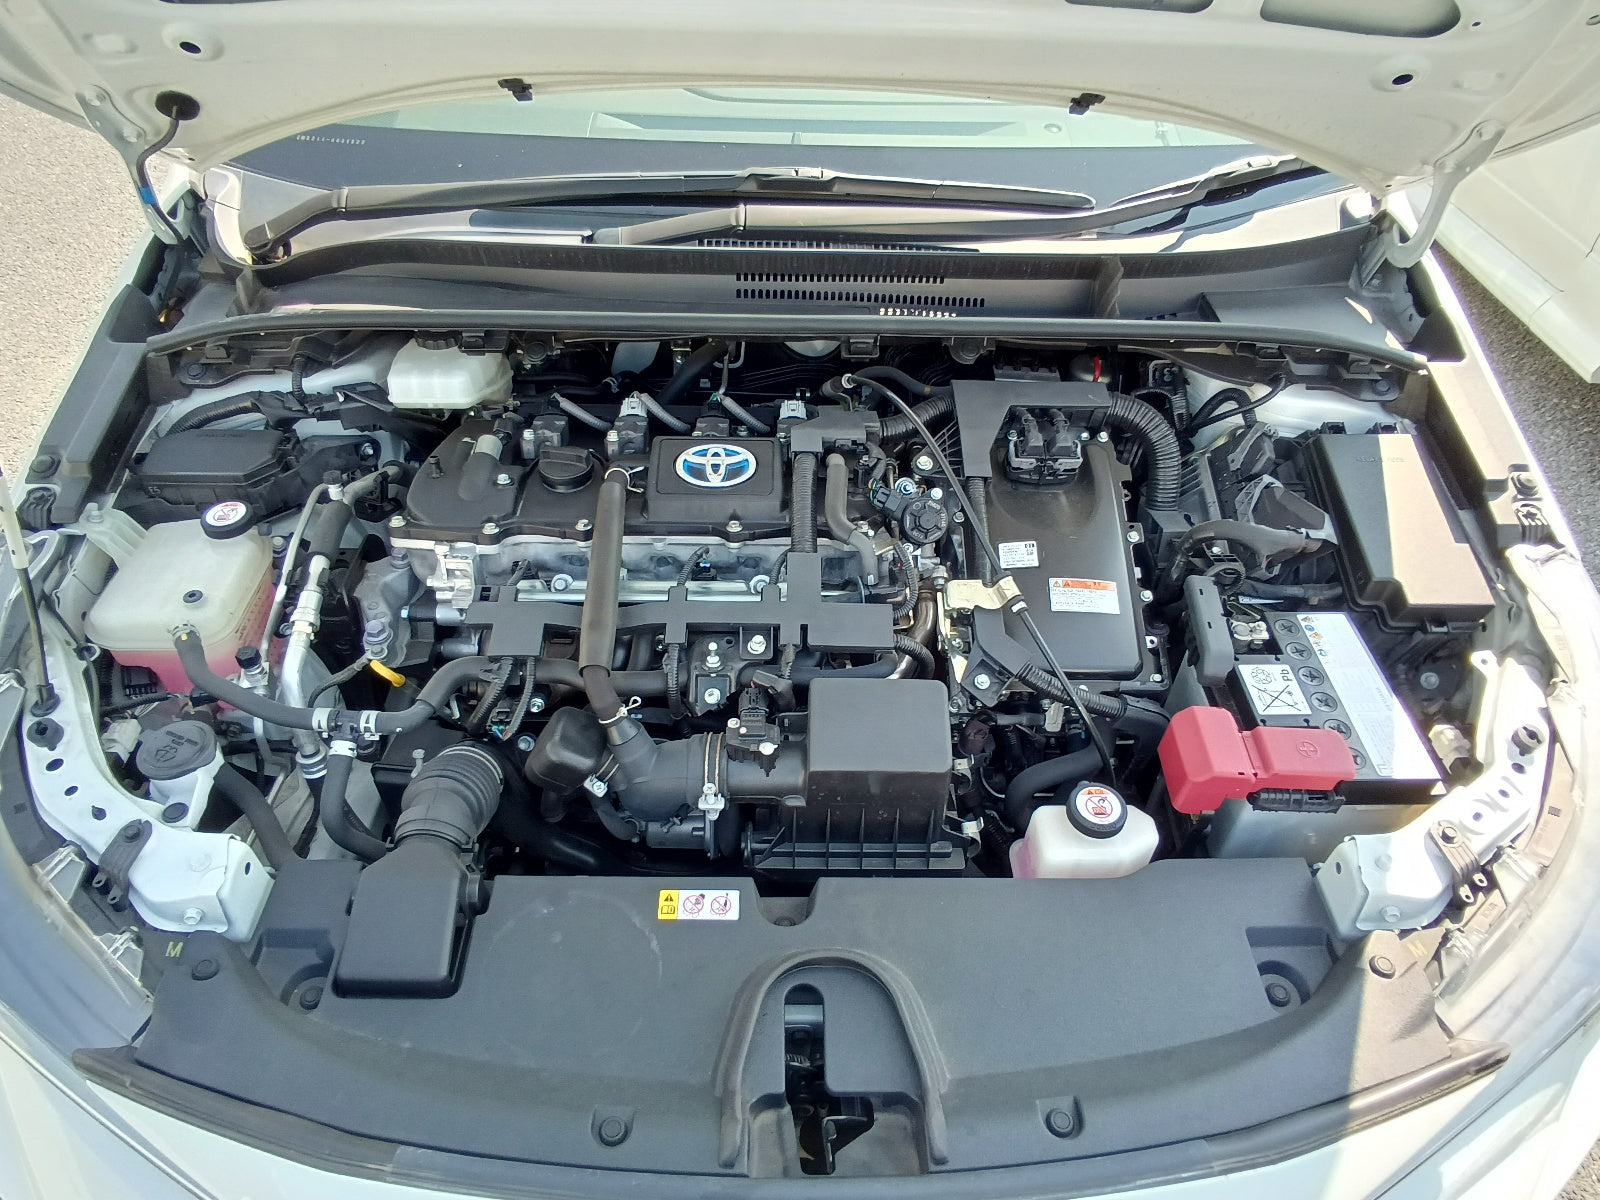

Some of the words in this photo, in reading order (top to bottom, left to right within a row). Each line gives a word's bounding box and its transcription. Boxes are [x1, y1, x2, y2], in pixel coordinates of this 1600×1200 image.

[1280, 669, 1293, 682] Pb
[165, 941, 184, 958] M
[1407, 940, 1428, 958] M
